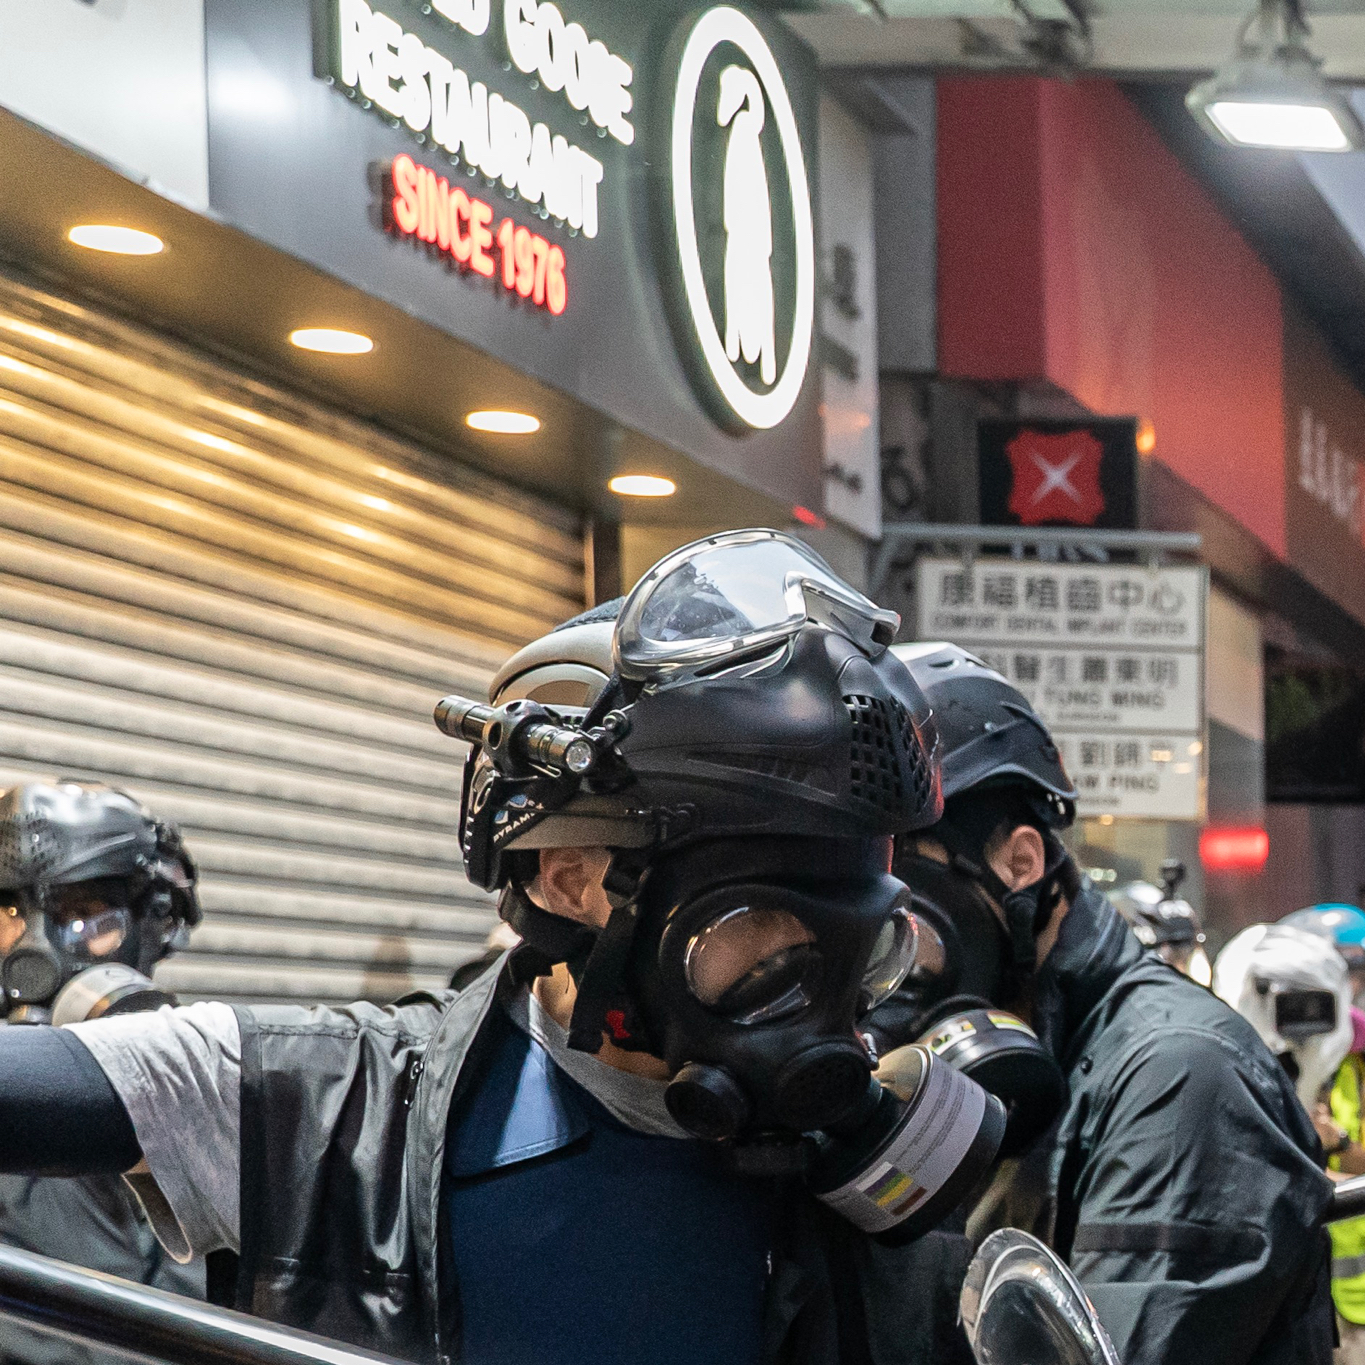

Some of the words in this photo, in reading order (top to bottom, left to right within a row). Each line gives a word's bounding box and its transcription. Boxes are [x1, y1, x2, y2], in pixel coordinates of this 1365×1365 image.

[339, 0, 603, 238] RESTAURANT
[392, 153, 495, 278] SINCE
[497, 217, 567, 316] 1976
